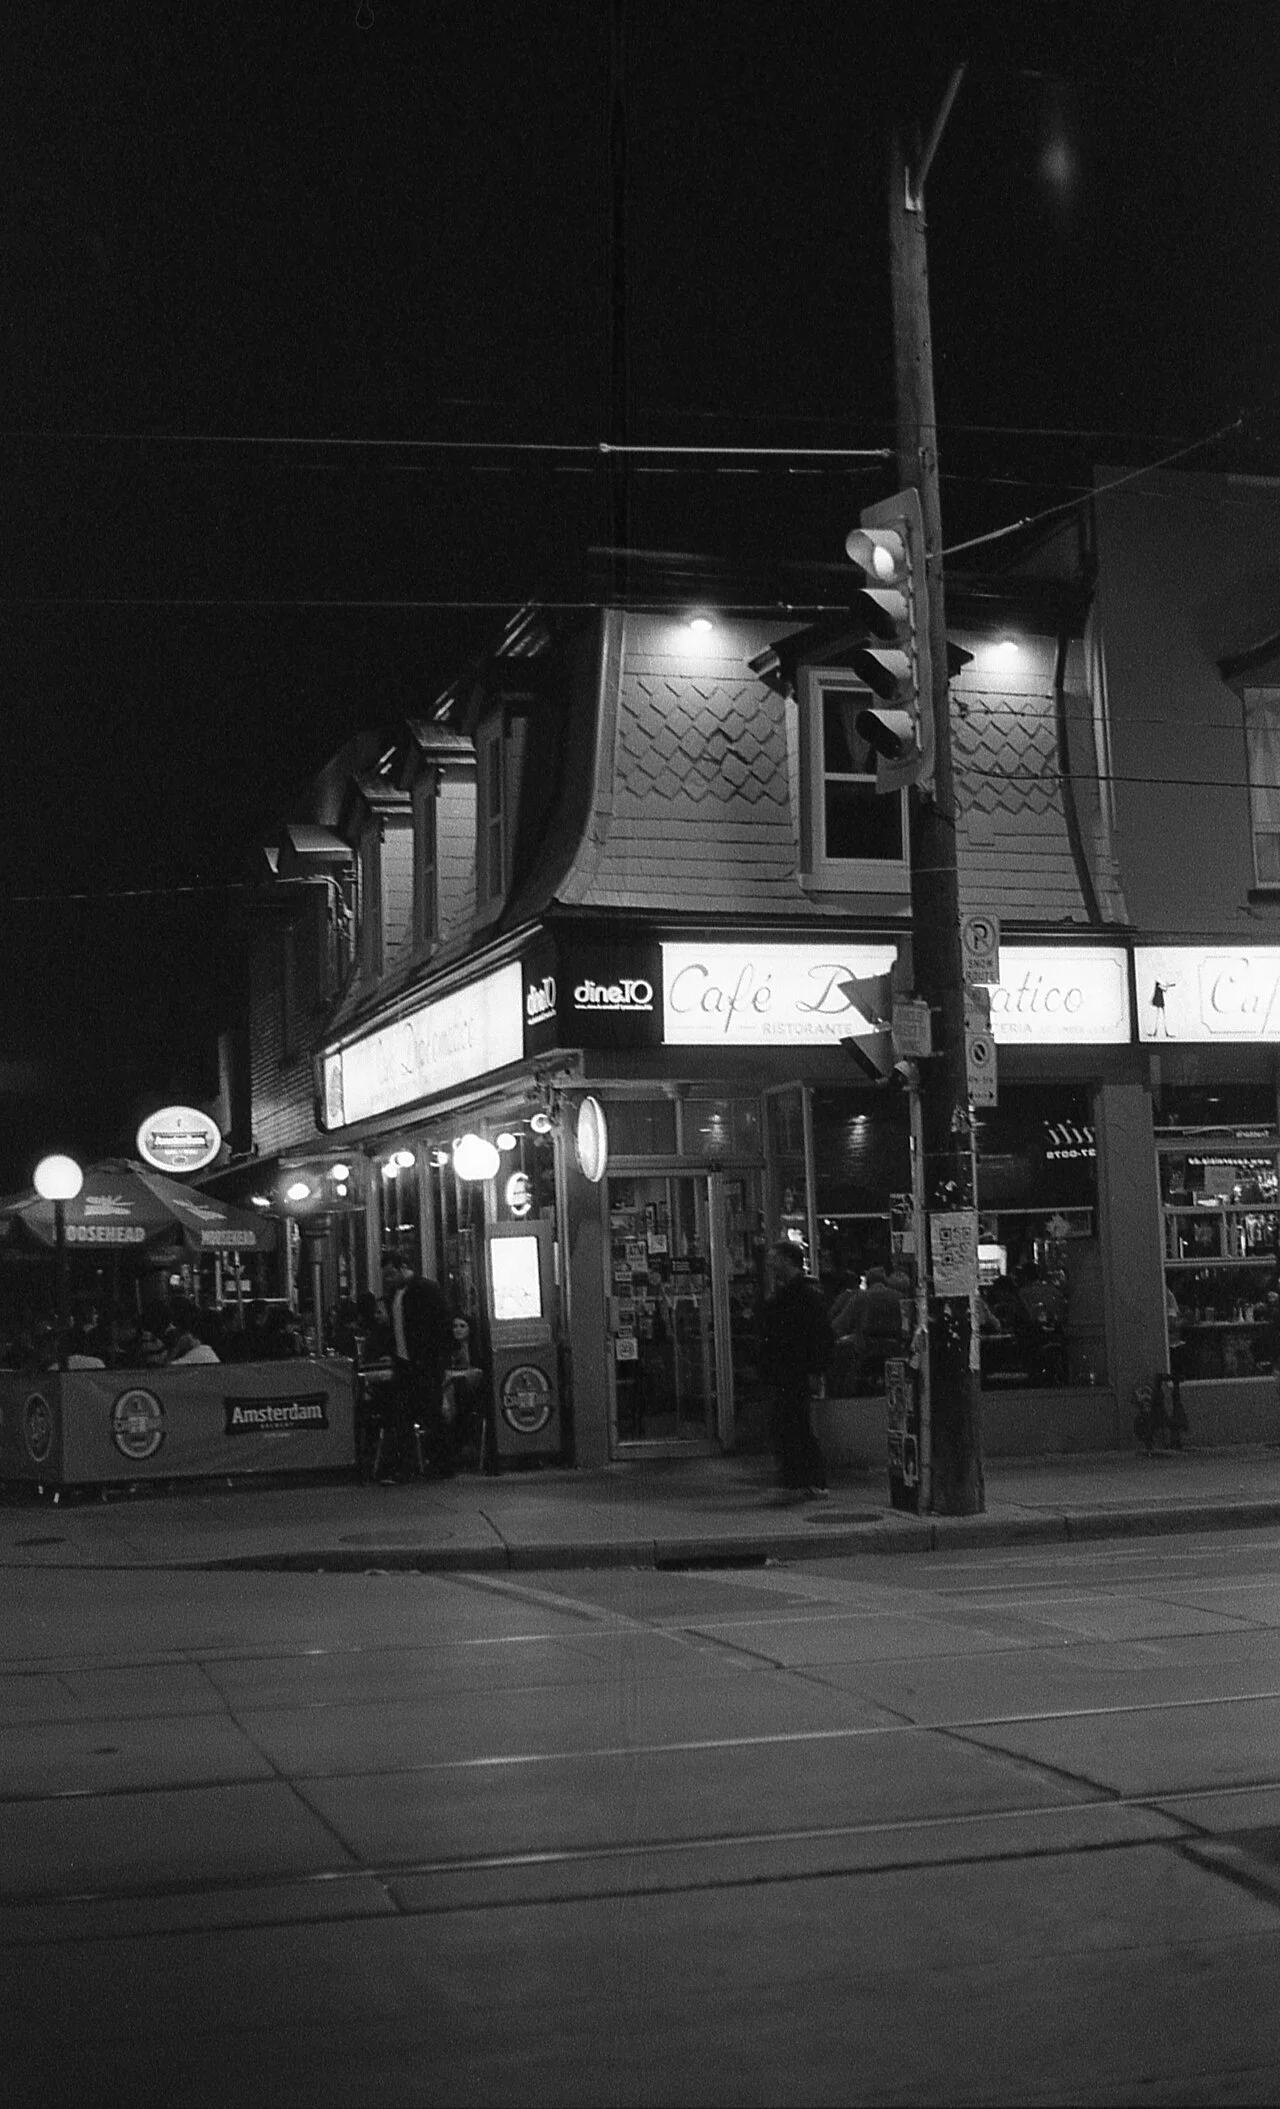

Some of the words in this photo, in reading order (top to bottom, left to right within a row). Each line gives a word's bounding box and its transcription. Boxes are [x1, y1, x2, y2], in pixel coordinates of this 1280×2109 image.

[968, 959, 993, 969] SNOW
[966, 971, 995, 982] ROUTE
[574, 979, 653, 1004] dineTO
[670, 963, 772, 1033] Café
[763, 1023, 853, 1035] RISTORANTE
[232, 1403, 323, 1424] Amsterdam
